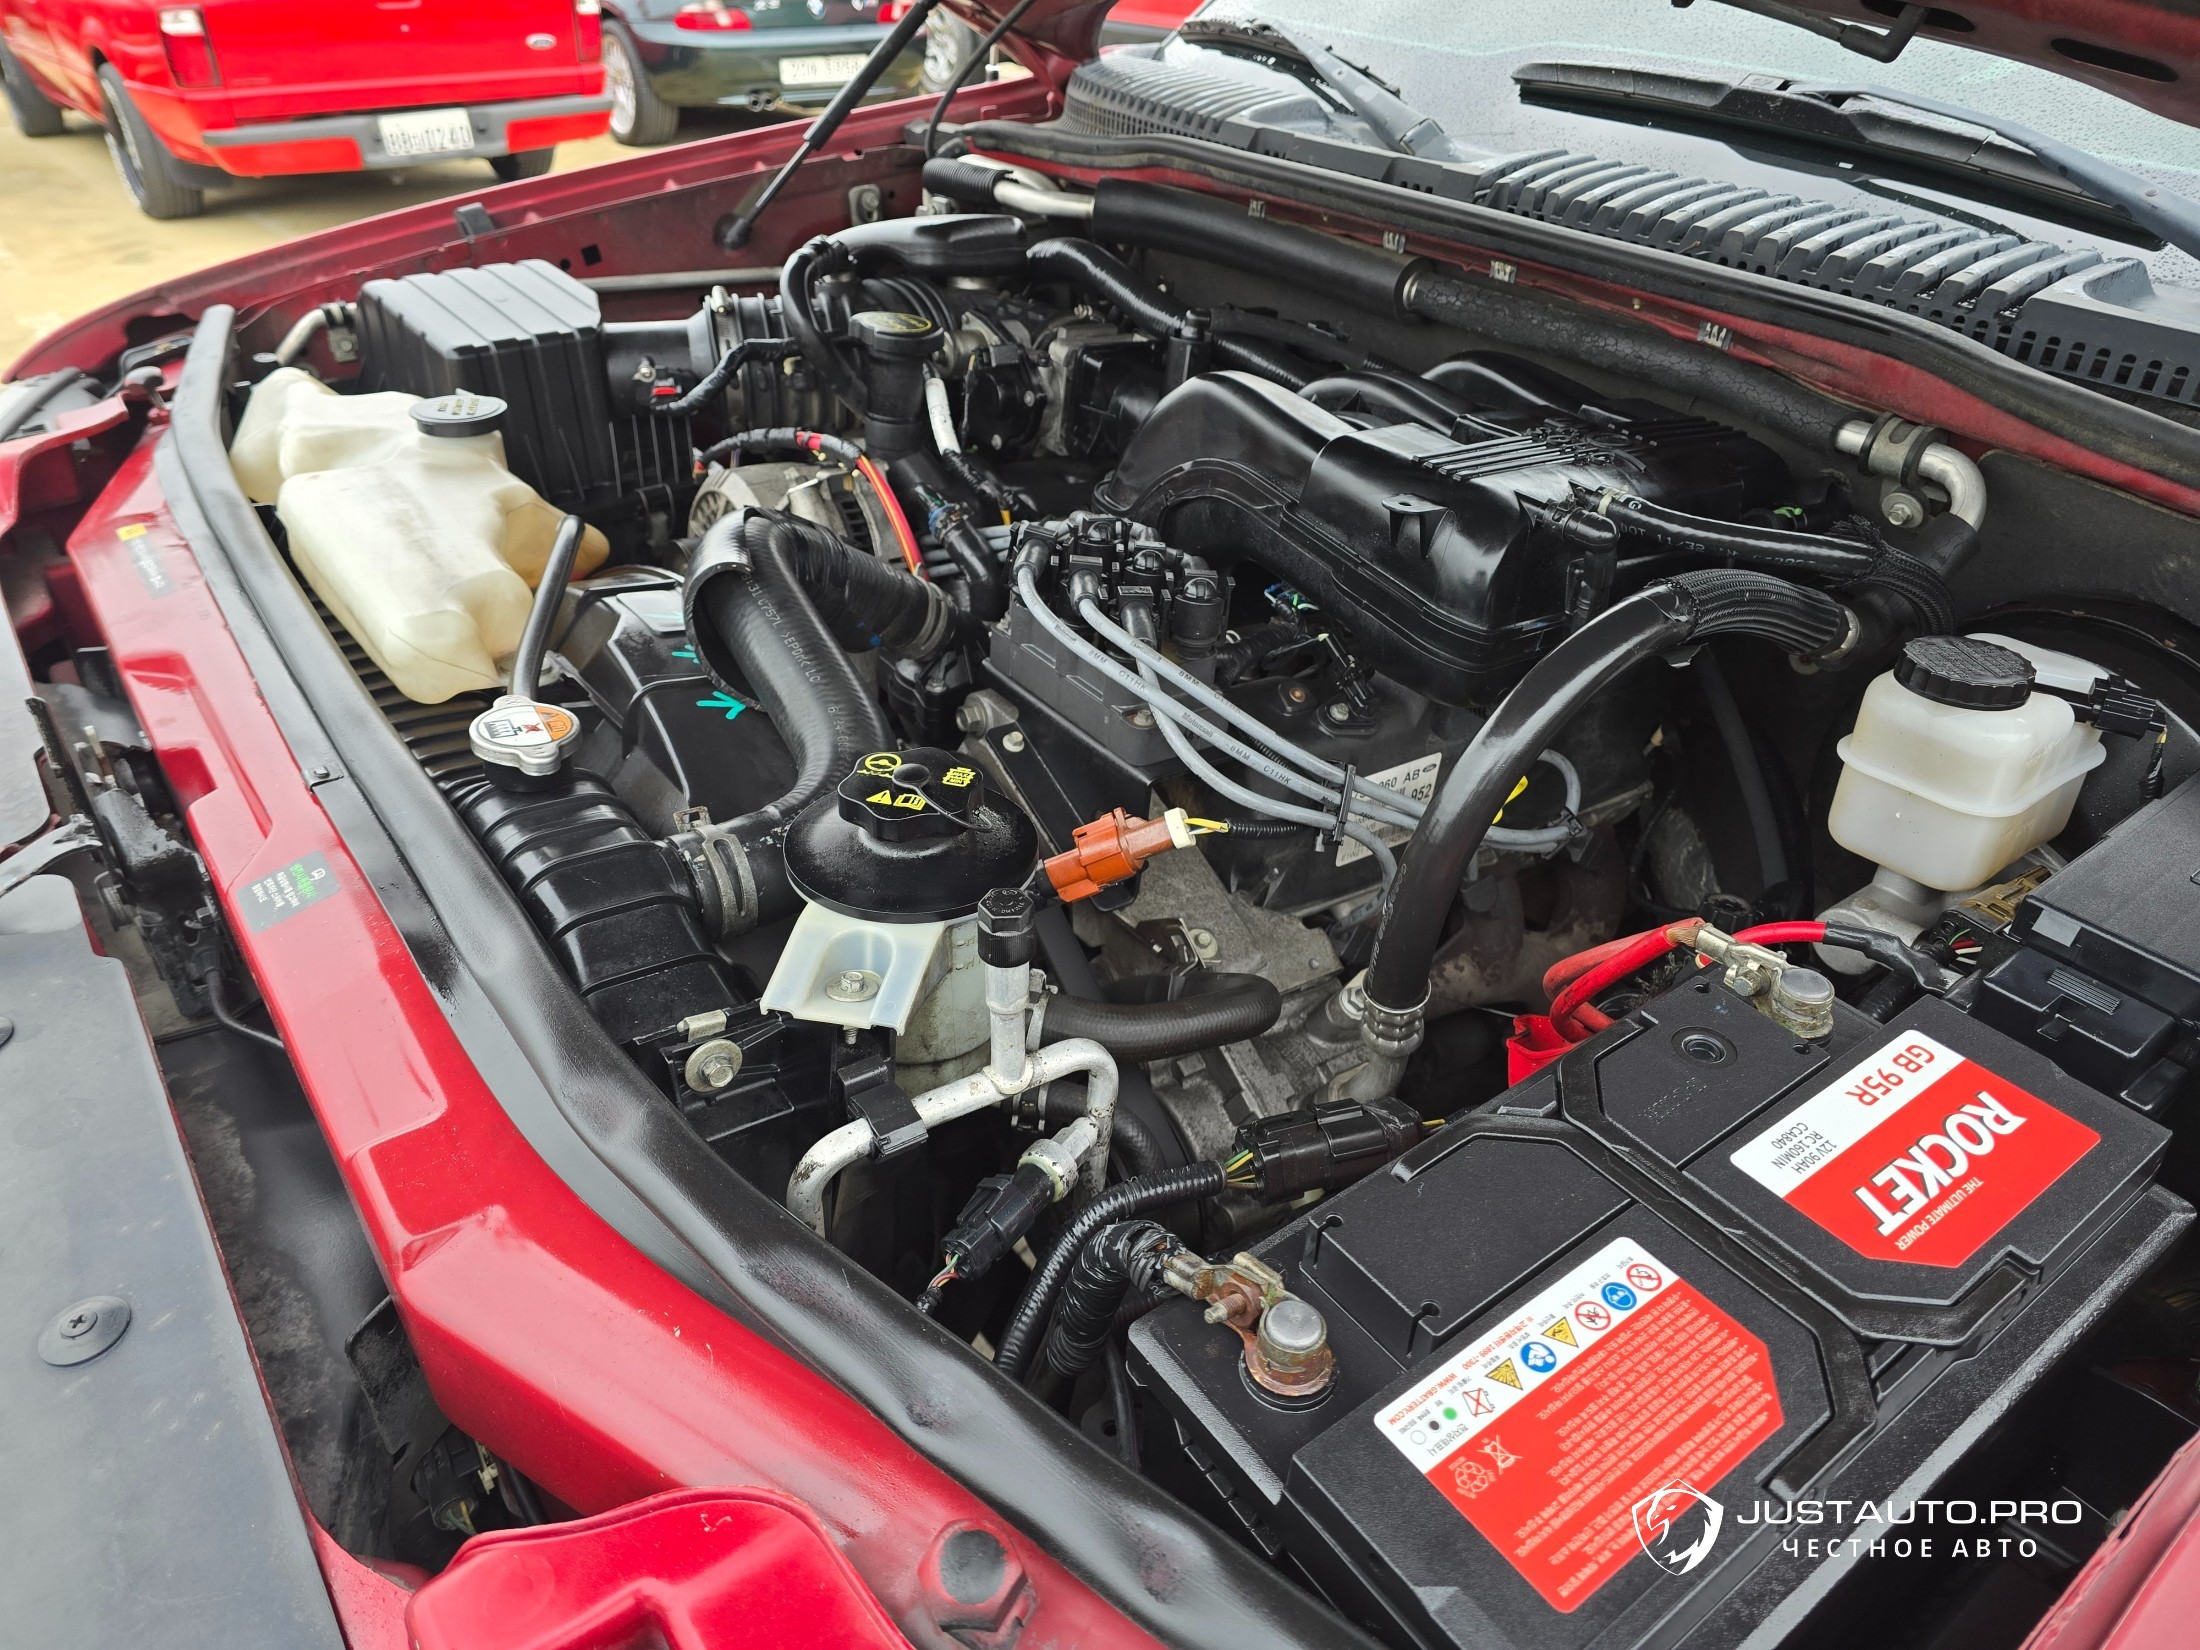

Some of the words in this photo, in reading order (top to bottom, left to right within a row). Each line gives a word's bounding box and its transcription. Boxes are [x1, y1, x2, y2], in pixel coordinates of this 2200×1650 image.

[1263, 765, 1291, 784] C11HK
[1403, 768, 1420, 783] AB
[1892, 1043, 1935, 1074] GB
[1845, 1068, 1903, 1106] 95R
[1770, 1121, 1808, 1150] CCA840
[1852, 1089, 2027, 1237] ROCKET
[1961, 1175, 1983, 1195] THE
[1924, 1188, 1966, 1225] ULTIMATE
[1893, 1218, 1929, 1250] POWER
[1493, 1320, 1527, 1347] 고객지원센터
[1462, 1356, 1479, 1370] -7300
[1479, 1344, 1495, 1357] 1899
[1388, 1373, 1457, 1425] WWW.GBATTERY.COM
[1427, 1423, 1469, 1456] 전지상태표시
